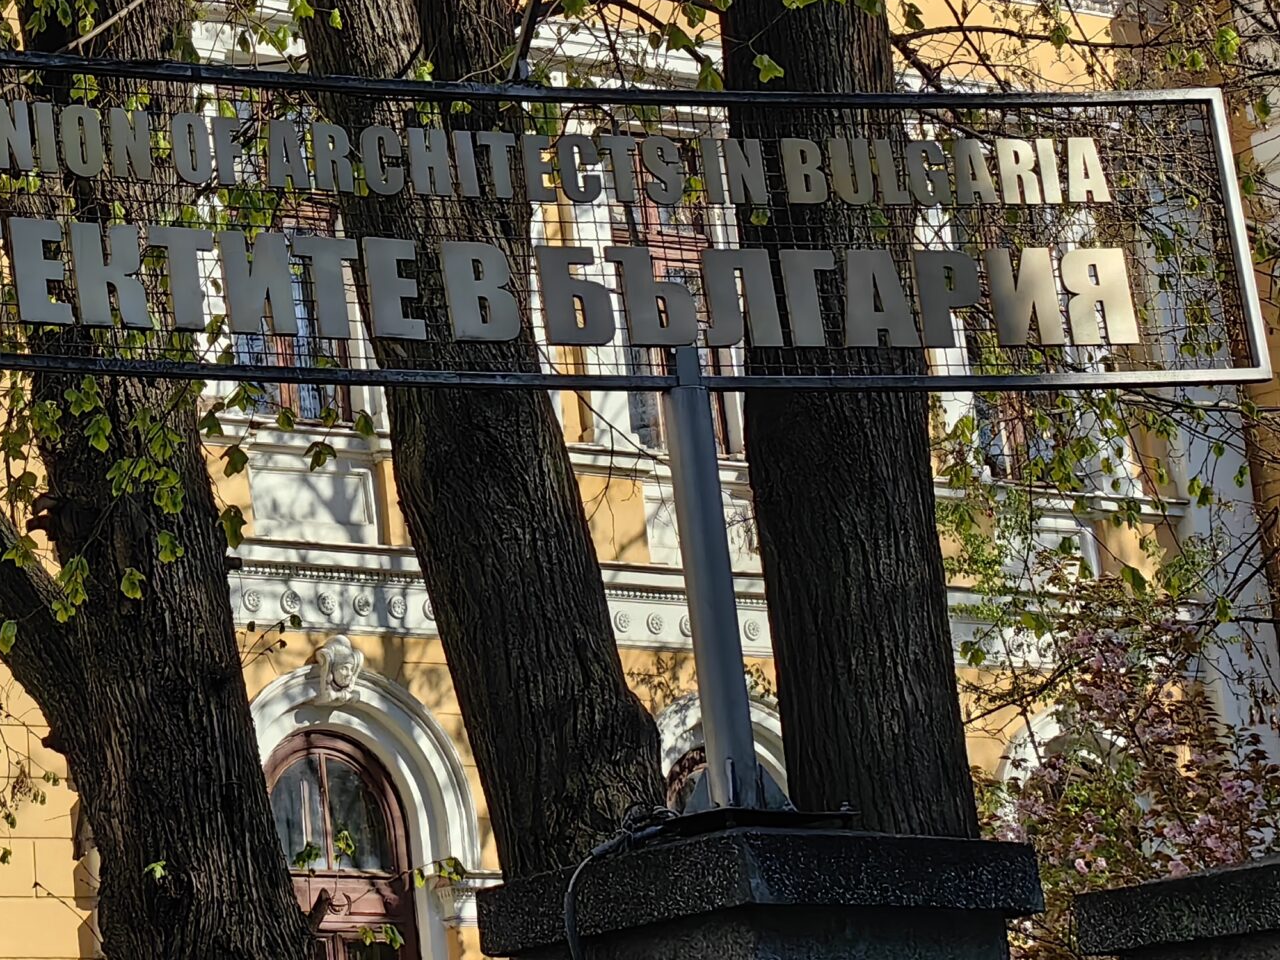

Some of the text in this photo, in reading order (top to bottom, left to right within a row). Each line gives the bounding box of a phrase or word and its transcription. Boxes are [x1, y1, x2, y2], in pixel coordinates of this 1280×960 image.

[173, 114, 243, 186] OF
[269, 119, 686, 205] ARCHITECTS
[702, 138, 770, 205] IN
[782, 138, 1112, 205] BULGARIA
[440, 241, 520, 342] В
[537, 247, 1141, 347] БЪЛГАРИЯ
